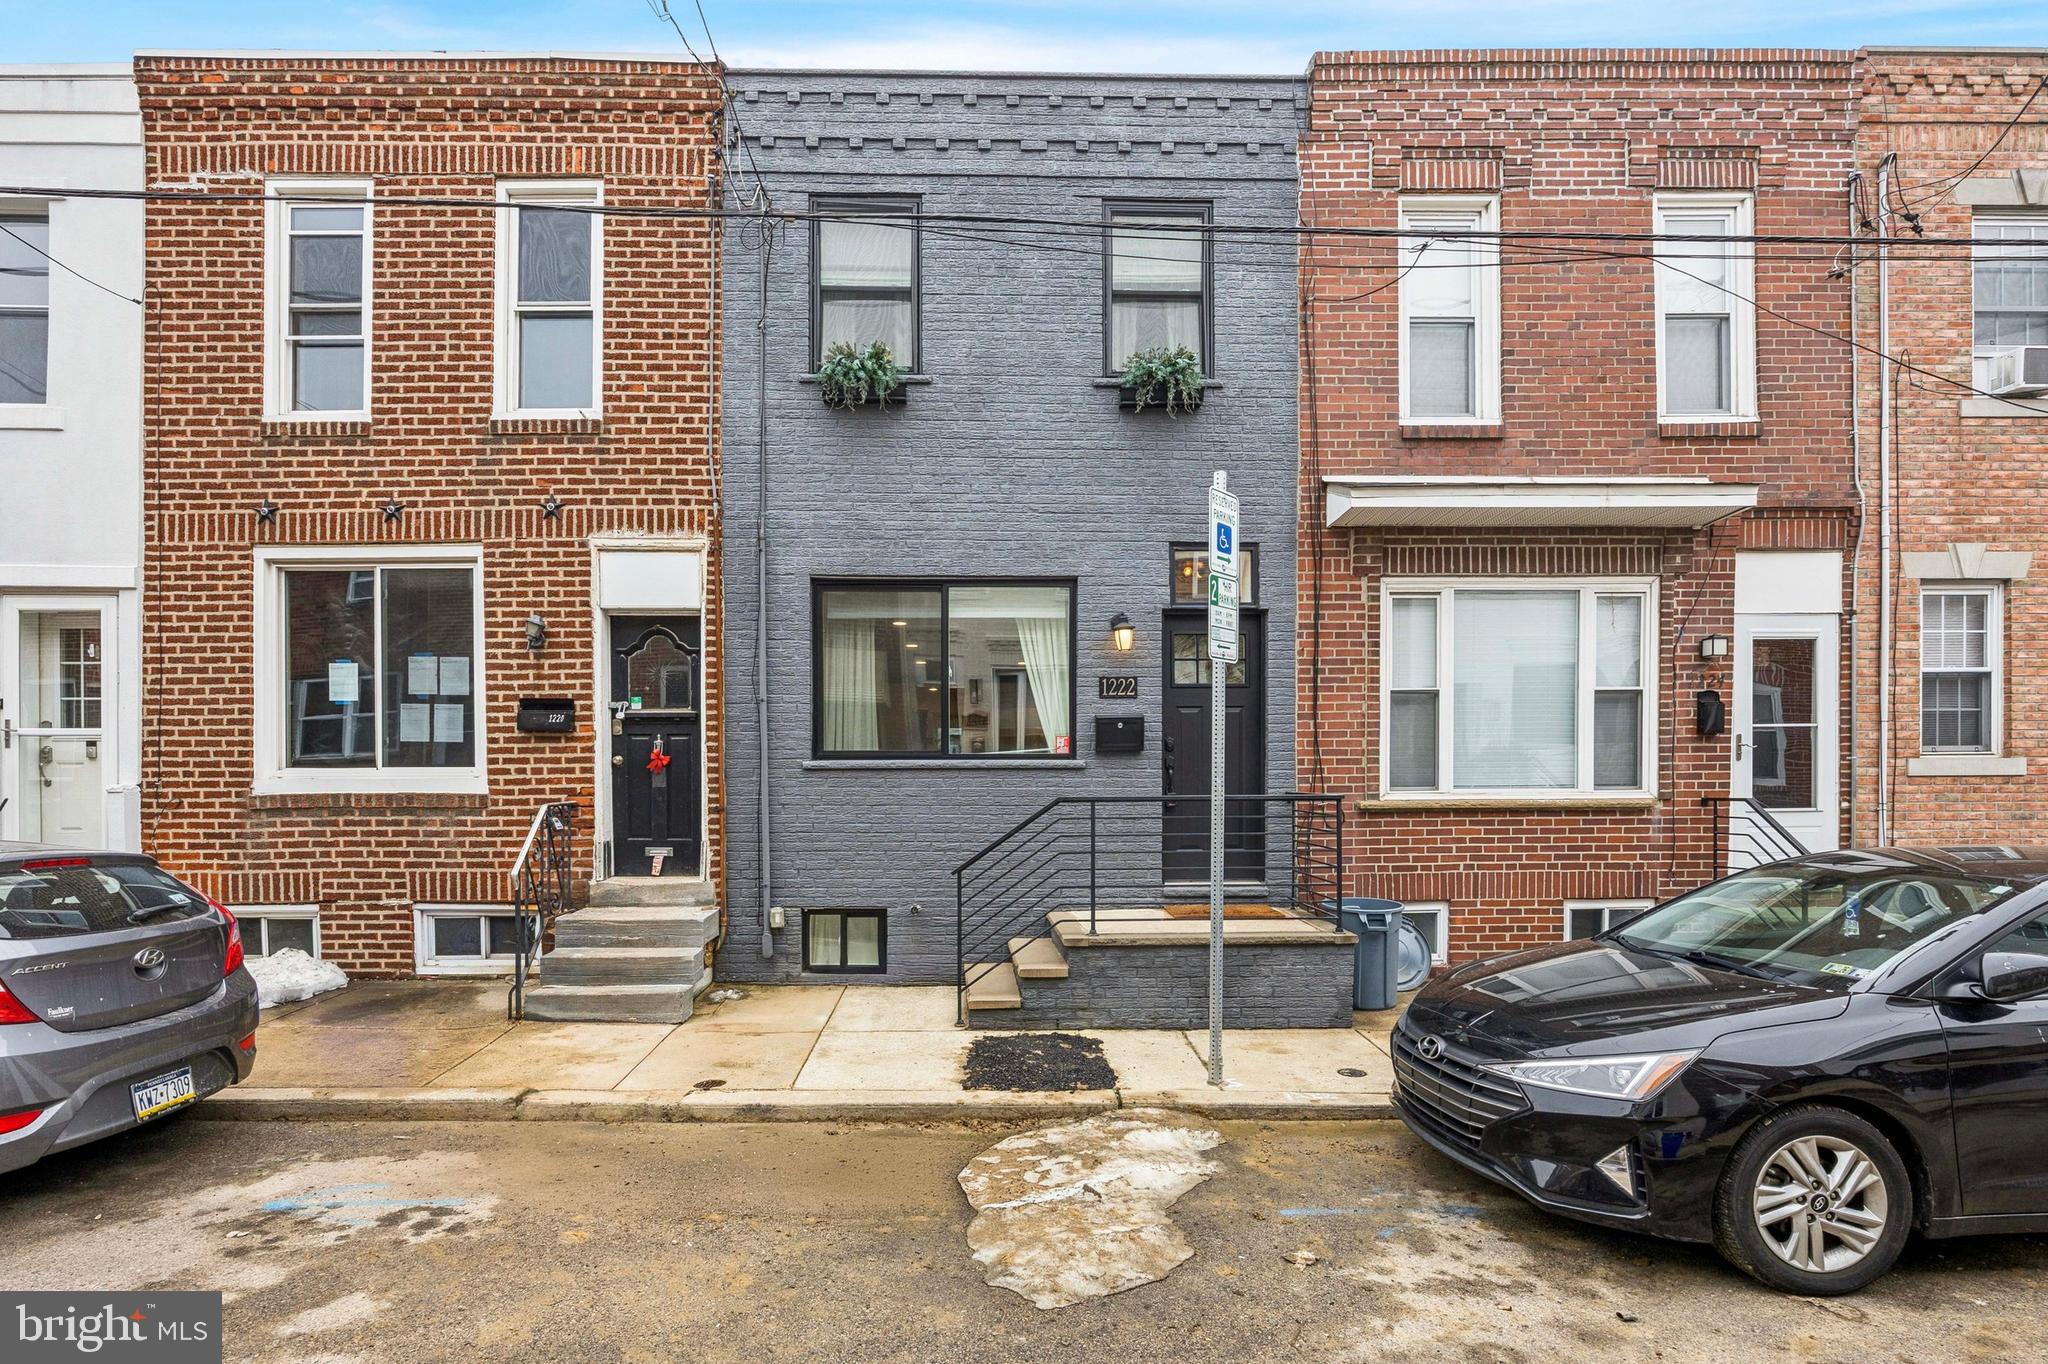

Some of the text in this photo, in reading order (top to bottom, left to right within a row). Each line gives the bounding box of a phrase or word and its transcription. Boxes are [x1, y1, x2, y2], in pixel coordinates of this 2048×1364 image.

[1212, 492, 1237, 512] RESERVED
[1213, 508, 1236, 527] PARKING
[1211, 580, 1217, 601] 2
[1219, 593, 1237, 608] PARKING
[1101, 678, 1136, 696] 1222
[11, 961, 70, 976] ACCENT
